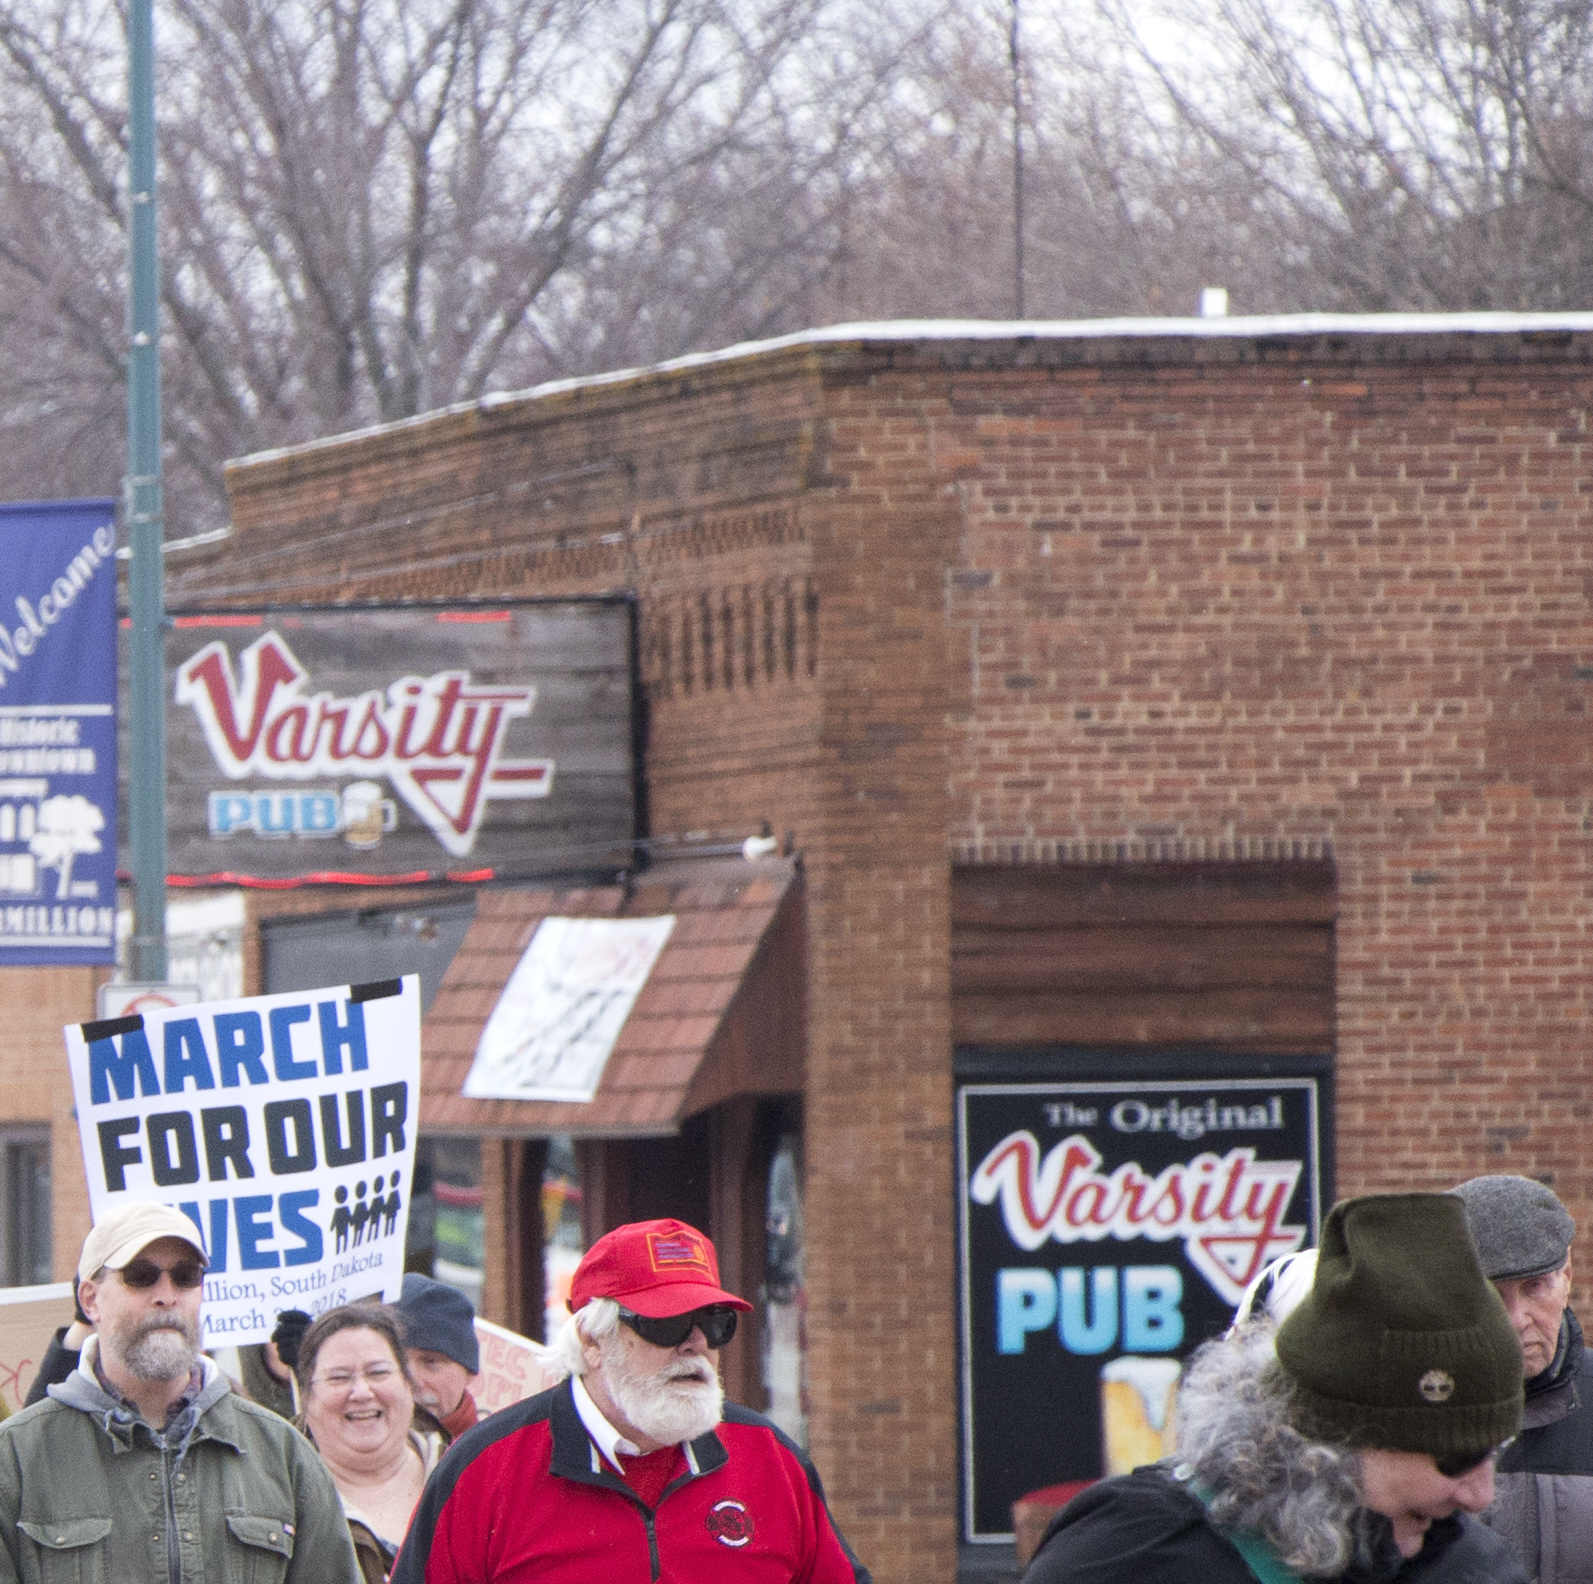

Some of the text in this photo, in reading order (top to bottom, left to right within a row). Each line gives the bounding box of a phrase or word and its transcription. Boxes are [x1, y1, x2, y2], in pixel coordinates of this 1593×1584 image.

[177, 633, 554, 856] Varsity
[210, 789, 339, 840] PUB
[88, 998, 369, 1105] MARCH
[97, 1081, 408, 1192] FOR OUR
[1044, 1097, 1283, 1138] The Original
[971, 1130, 1306, 1305] Varsity
[271, 1270, 327, 1297] South
[331, 1251, 383, 1284] Dakota
[996, 1265, 1184, 1355] PUB
